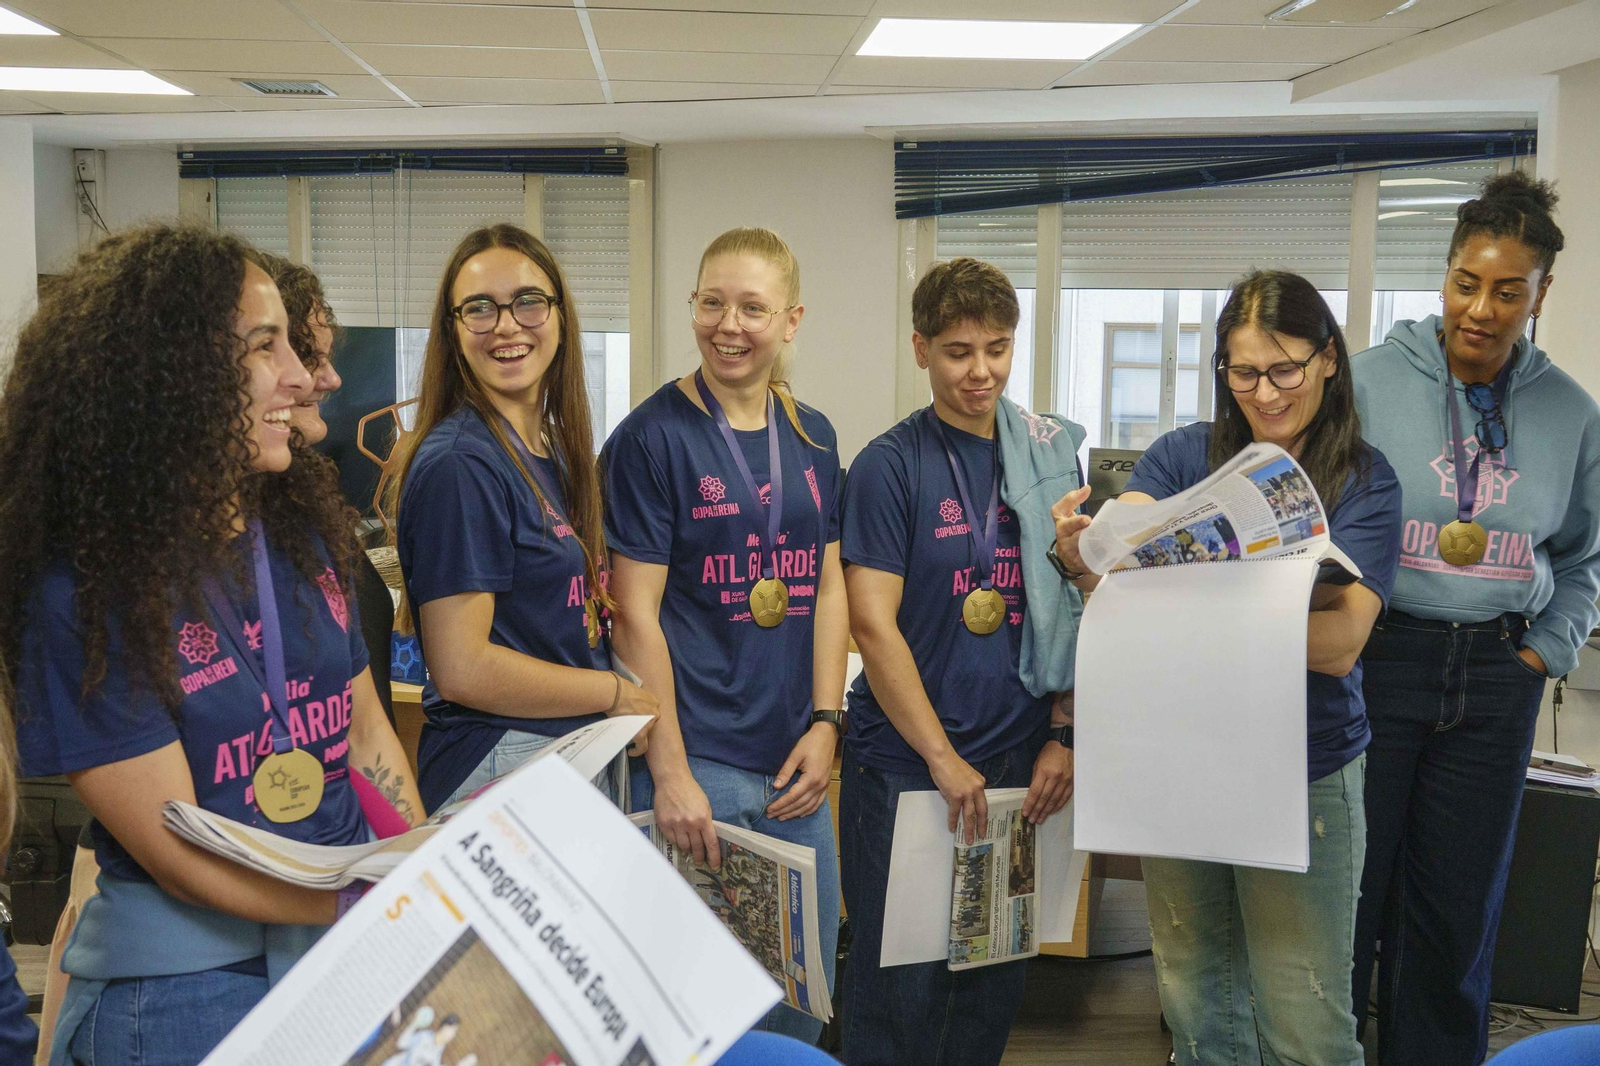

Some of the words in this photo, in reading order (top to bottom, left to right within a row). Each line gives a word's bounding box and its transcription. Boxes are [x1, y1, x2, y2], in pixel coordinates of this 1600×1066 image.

[1099, 460, 1134, 472] ace
[692, 506, 713, 519] COPA
[718, 503, 740, 516] REINA
[956, 523, 972, 536] REIN
[995, 546, 1020, 558] ecali
[1483, 530, 1535, 566] EINA
[702, 554, 745, 584] ATL.
[180, 668, 207, 694] COPA
[214, 656, 238, 679] REIN
[458, 830, 480, 851] A
[471, 844, 542, 927] Sangriña
[539, 922, 589, 986] decide
[790, 872, 799, 914] Atlántico
